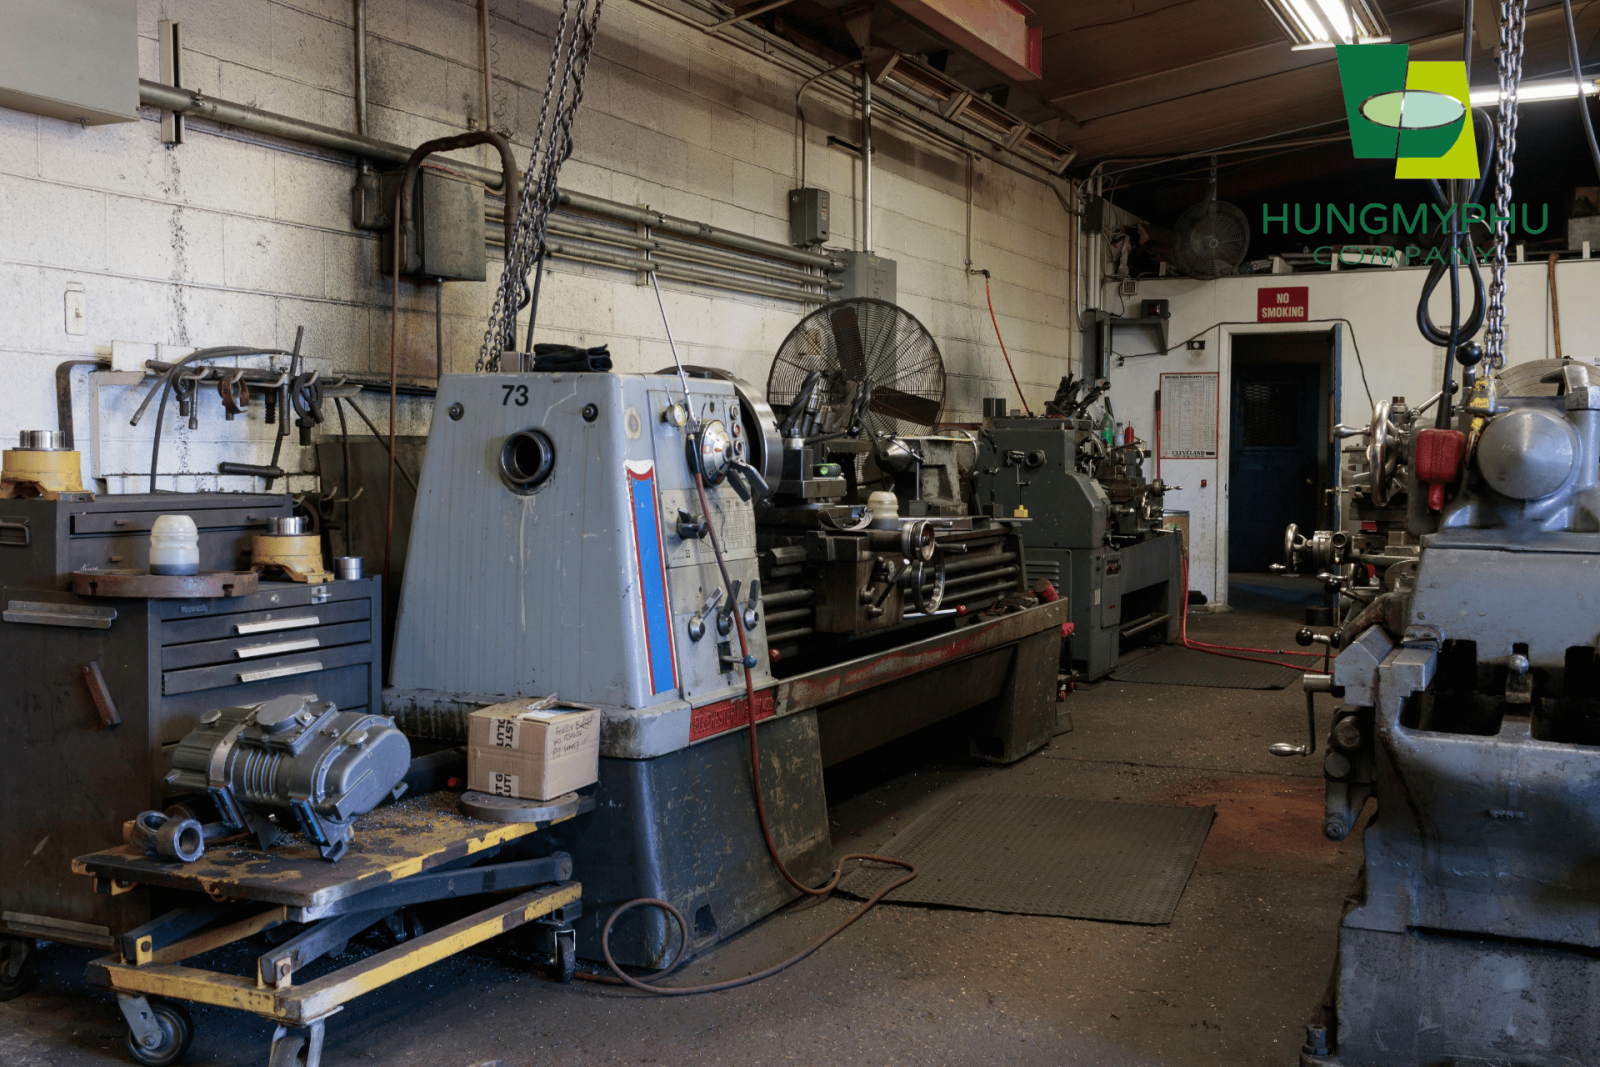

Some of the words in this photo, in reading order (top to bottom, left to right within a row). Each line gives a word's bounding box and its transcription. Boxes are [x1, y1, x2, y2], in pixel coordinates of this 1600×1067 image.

[1276, 292, 1290, 304] NO
[1261, 306, 1304, 318] SMOKING
[502, 384, 529, 407] 73
